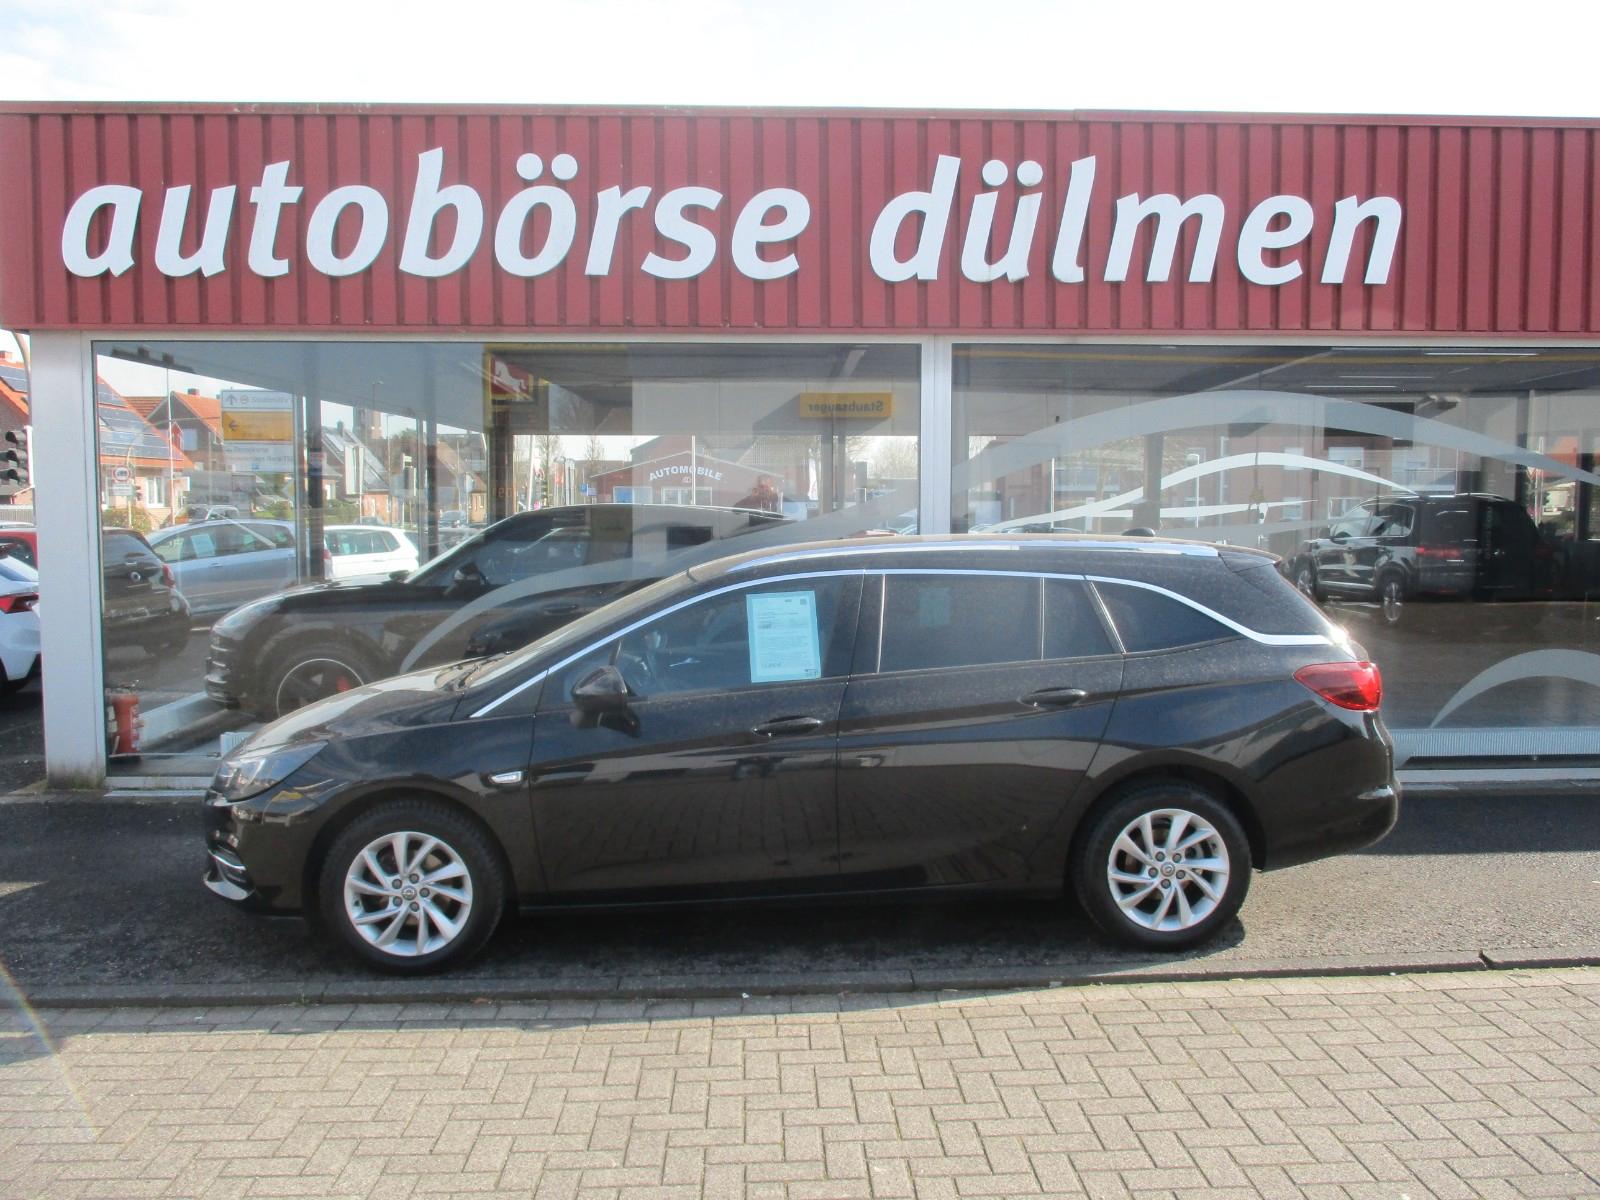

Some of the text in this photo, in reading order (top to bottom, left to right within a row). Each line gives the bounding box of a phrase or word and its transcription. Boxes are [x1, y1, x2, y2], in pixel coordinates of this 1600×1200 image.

[61, 147, 1403, 286] autobörse dülmen
[649, 465, 722, 481] AUTOMOBILE
